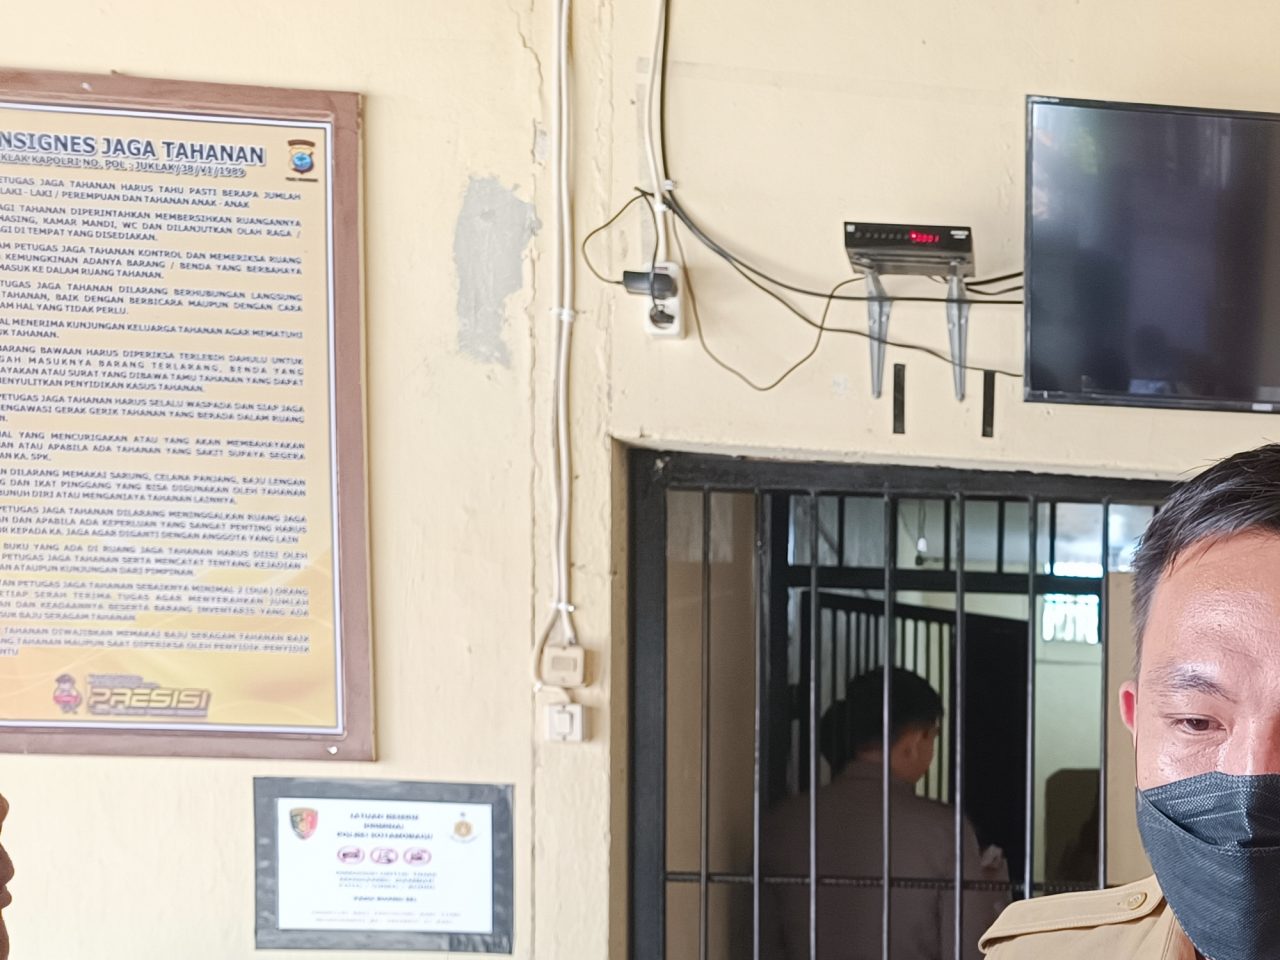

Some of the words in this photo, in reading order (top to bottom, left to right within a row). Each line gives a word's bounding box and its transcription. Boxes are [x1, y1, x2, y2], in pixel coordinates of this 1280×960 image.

[0, 131, 95, 158] NSIGNES
[101, 137, 156, 161] JAGA
[162, 140, 266, 167] TAHANAN
[0, 153, 29, 166] KLAK
[32, 155, 80, 169] KAPOLRI
[105, 159, 124, 172] POL
[0, 176, 34, 186] ETUGAS
[40, 178, 64, 188] JAGA
[70, 180, 115, 190] TAHANAN
[120, 183, 153, 192] HARUS
[159, 185, 184, 194] TAHU
[189, 187, 216, 196] PASTI
[222, 188, 258, 198] BERAPA
[264, 191, 300, 200] JUMLAH
[0, 187, 22, 196] LAKI
[30, 189, 52, 198] LAKI
[61, 191, 120, 201] PEREMPUAN
[122, 194, 142, 202] DAN
[144, 195, 189, 205] TAHANAN
[191, 198, 216, 206] ANAK
[224, 199, 249, 208] ANAK
[0, 204, 14, 212] AGI
[20, 205, 66, 215] TAHANAN
[70, 207, 150, 219] DIPERINTAHKAN
[154, 212, 232, 224] MEMBERSIHKAN
[0, 214, 41, 224] ASING,
[42, 216, 76, 226] KAMAR
[122, 221, 137, 229] WC
[142, 222, 162, 230] DAN
[14, 226, 25, 234] DI
[28, 227, 64, 236] TEMPAT
[67, 229, 93, 238] YANG
[14, 242, 58, 252] PETUGAS
[62, 245, 85, 254] JAGA
[90, 246, 134, 256] TAHANAN
[138, 249, 181, 258] KONTROL
[0, 264, 30, 272] ASUK
[0, 279, 31, 288] TUGAS
[88, 687, 211, 709] PRESISI
